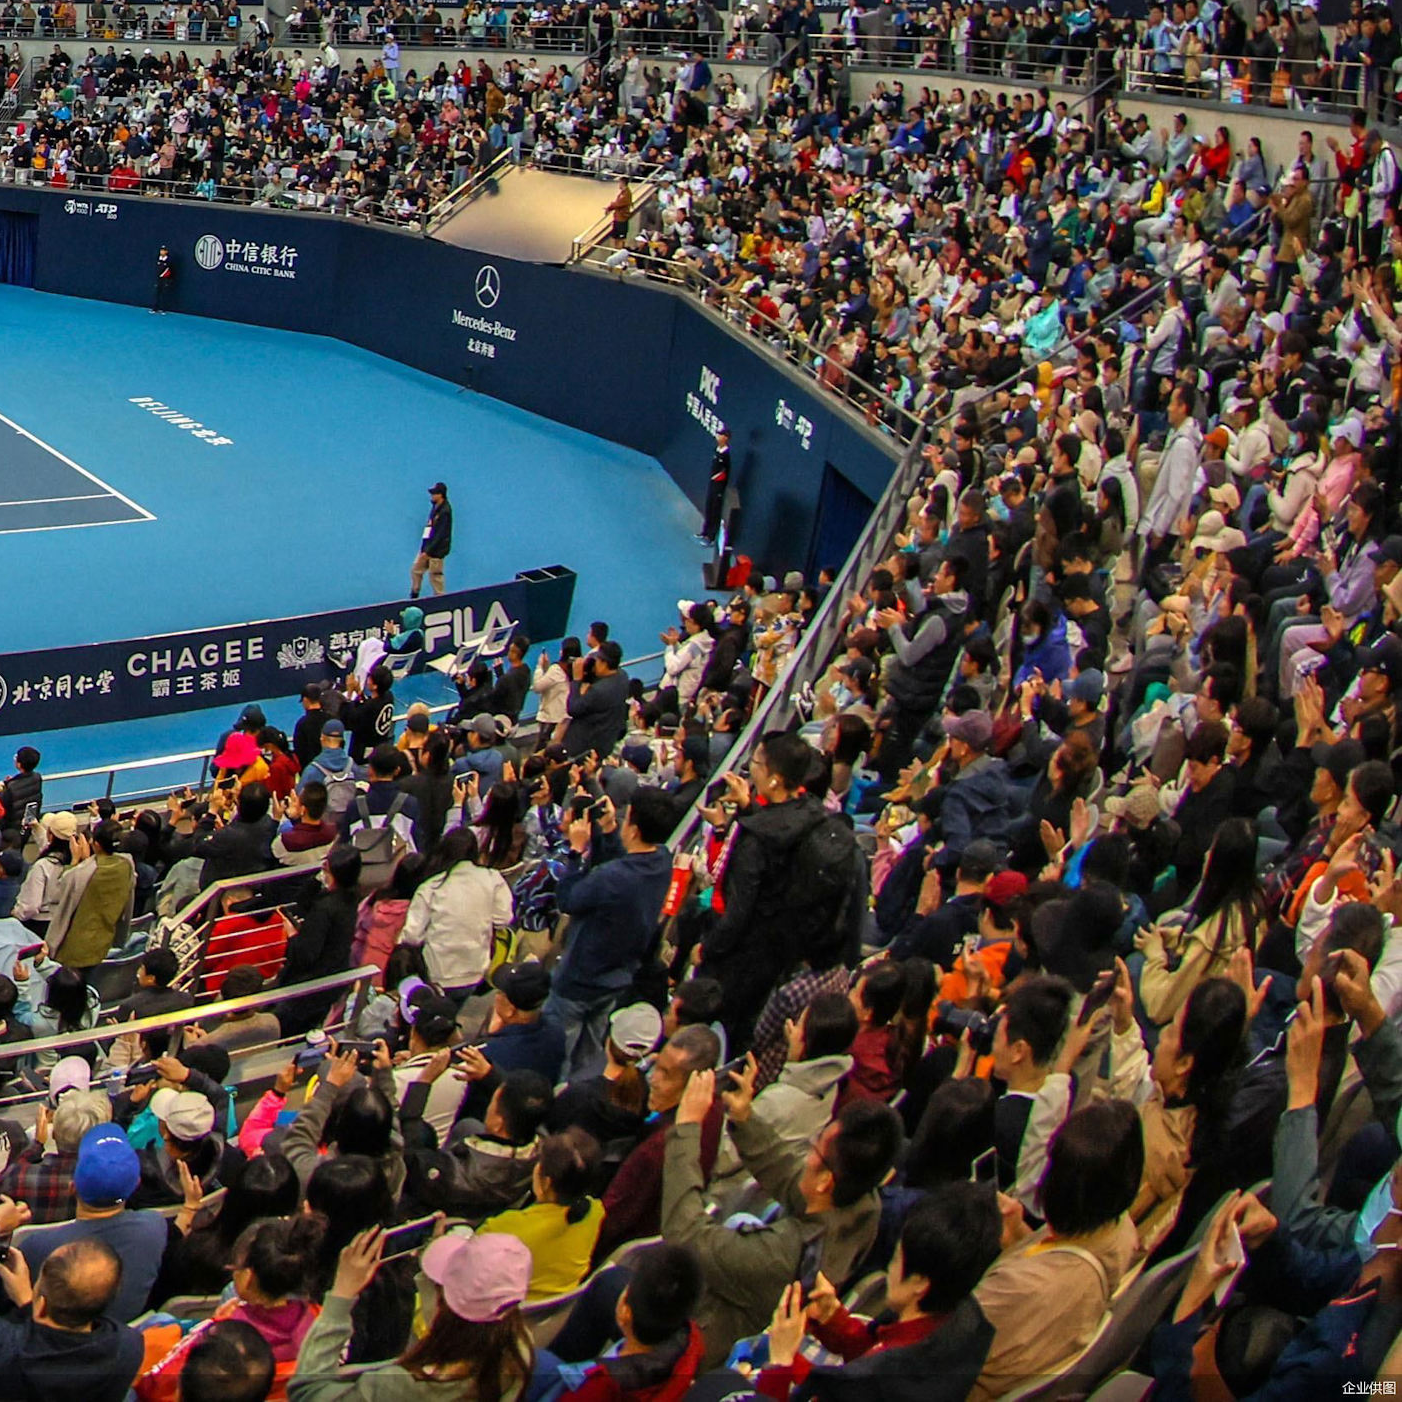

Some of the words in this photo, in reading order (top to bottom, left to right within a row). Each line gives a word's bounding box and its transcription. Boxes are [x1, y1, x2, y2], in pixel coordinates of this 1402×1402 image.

[96, 204, 117, 214] ATP
[226, 239, 298, 268] 中信银行
[225, 262, 250, 273] CHINA
[251, 266, 272, 276] CITIC
[274, 268, 296, 279] BANK
[452, 309, 516, 341] Mercedes-Benz
[128, 396, 203, 432] BEIJING
[191, 428, 234, 446] 北京
[424, 600, 514, 654] FILA
[126, 636, 265, 678] CHAGEE
[12, 670, 116, 705] 北京同仁堂
[151, 669, 242, 698] 霸王茶姬
